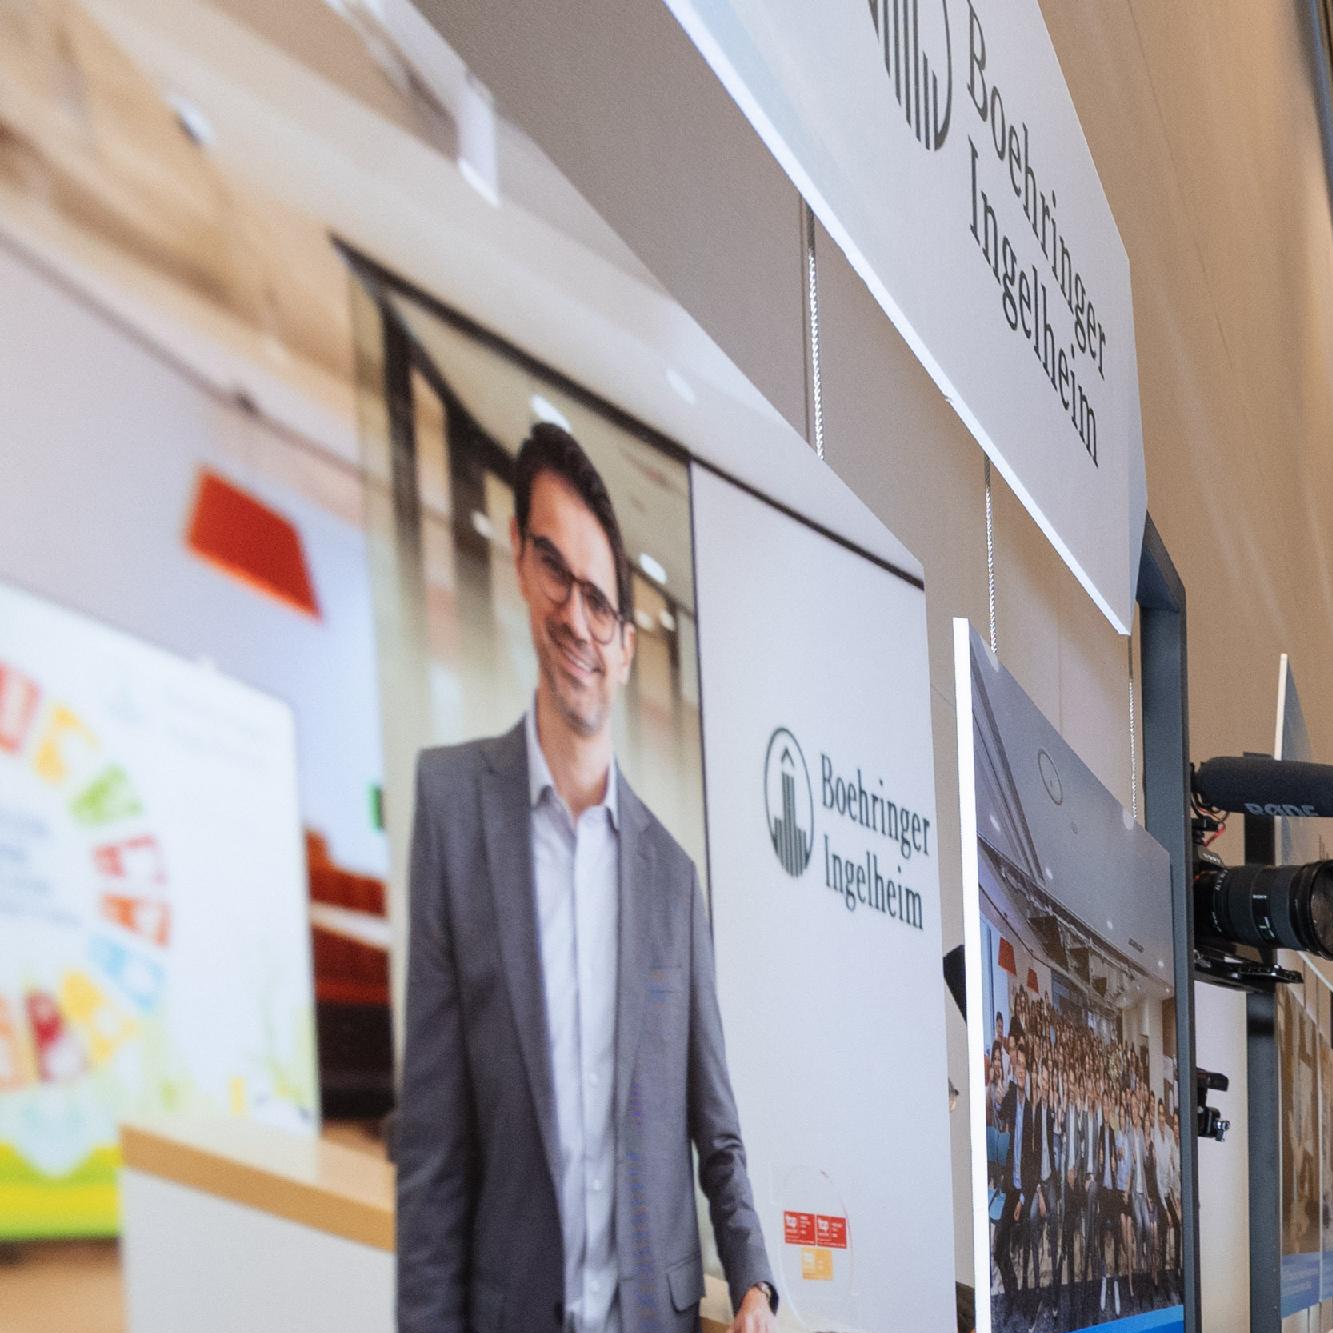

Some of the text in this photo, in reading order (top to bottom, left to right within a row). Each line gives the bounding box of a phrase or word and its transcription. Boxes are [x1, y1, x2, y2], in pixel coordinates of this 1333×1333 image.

[967, 0, 1106, 380] Boehringer
[967, 134, 1099, 468] Ingelheim
[821, 753, 931, 859] Boehringer
[823, 833, 924, 930] Ingelheim
